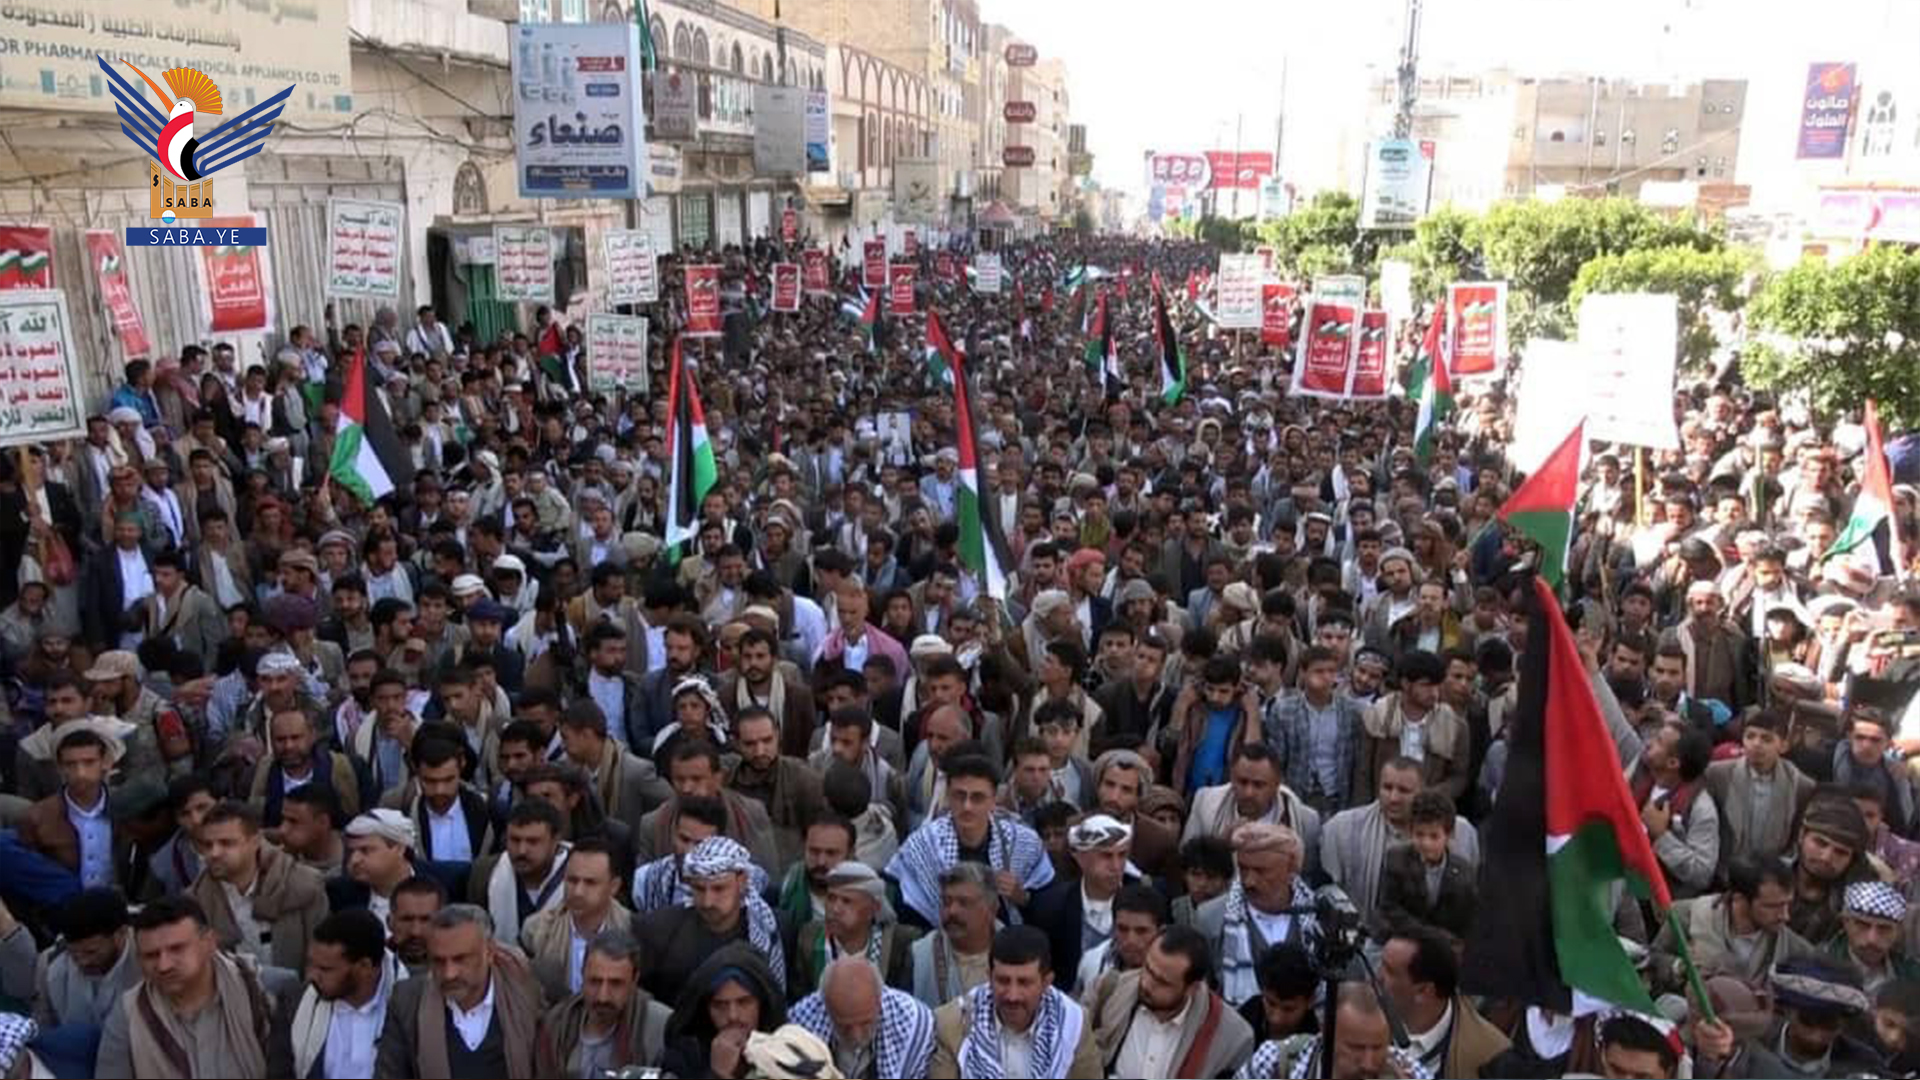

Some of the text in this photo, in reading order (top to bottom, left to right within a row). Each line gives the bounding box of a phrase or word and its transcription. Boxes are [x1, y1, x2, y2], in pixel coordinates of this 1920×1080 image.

[526, 110, 624, 147] صنعاء
[18, 311, 57, 333] الله
[17, 341, 62, 360] الموت
[20, 364, 65, 383] الموت
[30, 406, 72, 428] النصر
